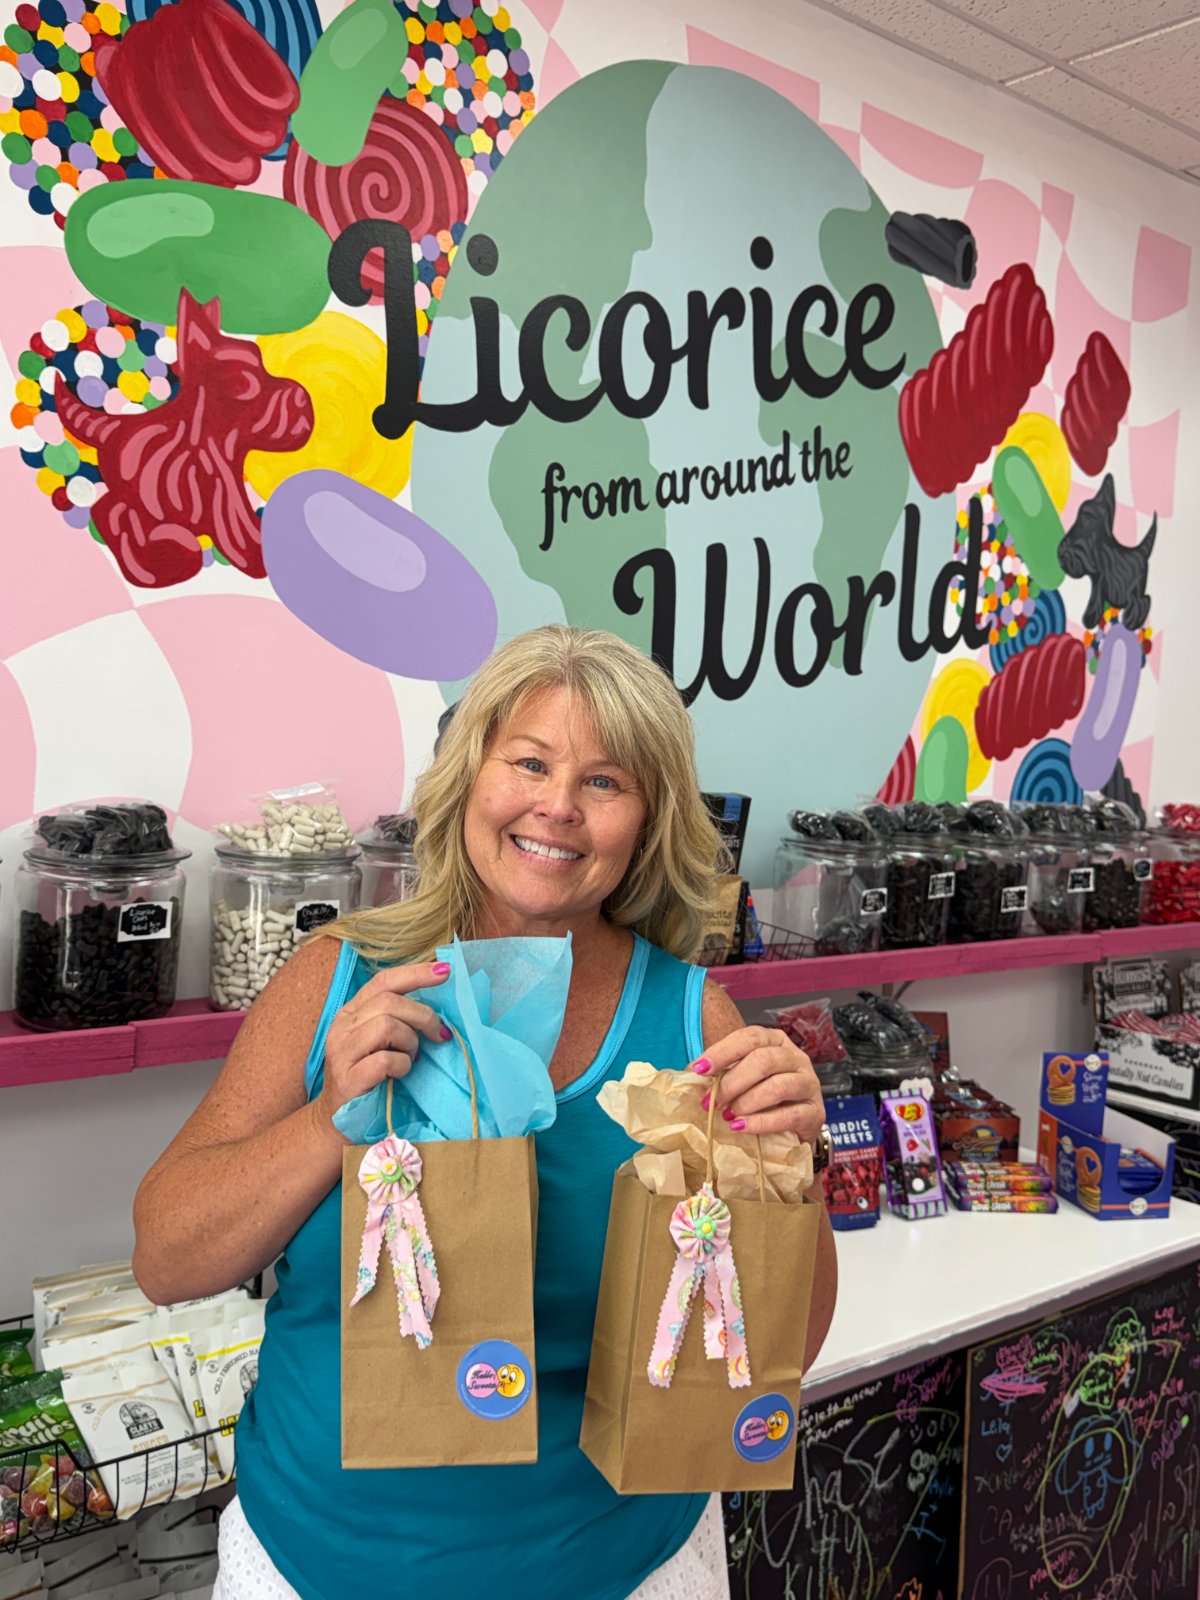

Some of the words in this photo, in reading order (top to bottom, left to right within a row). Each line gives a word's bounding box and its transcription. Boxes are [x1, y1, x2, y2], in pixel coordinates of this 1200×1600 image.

[328, 218, 906, 440] Licorice
[539, 462, 650, 551] from
[656, 430, 796, 508] around
[799, 425, 853, 483] the
[613, 497, 992, 706] World
[827, 1119, 870, 1134] ORDIC
[831, 1131, 874, 1145] WEETS
